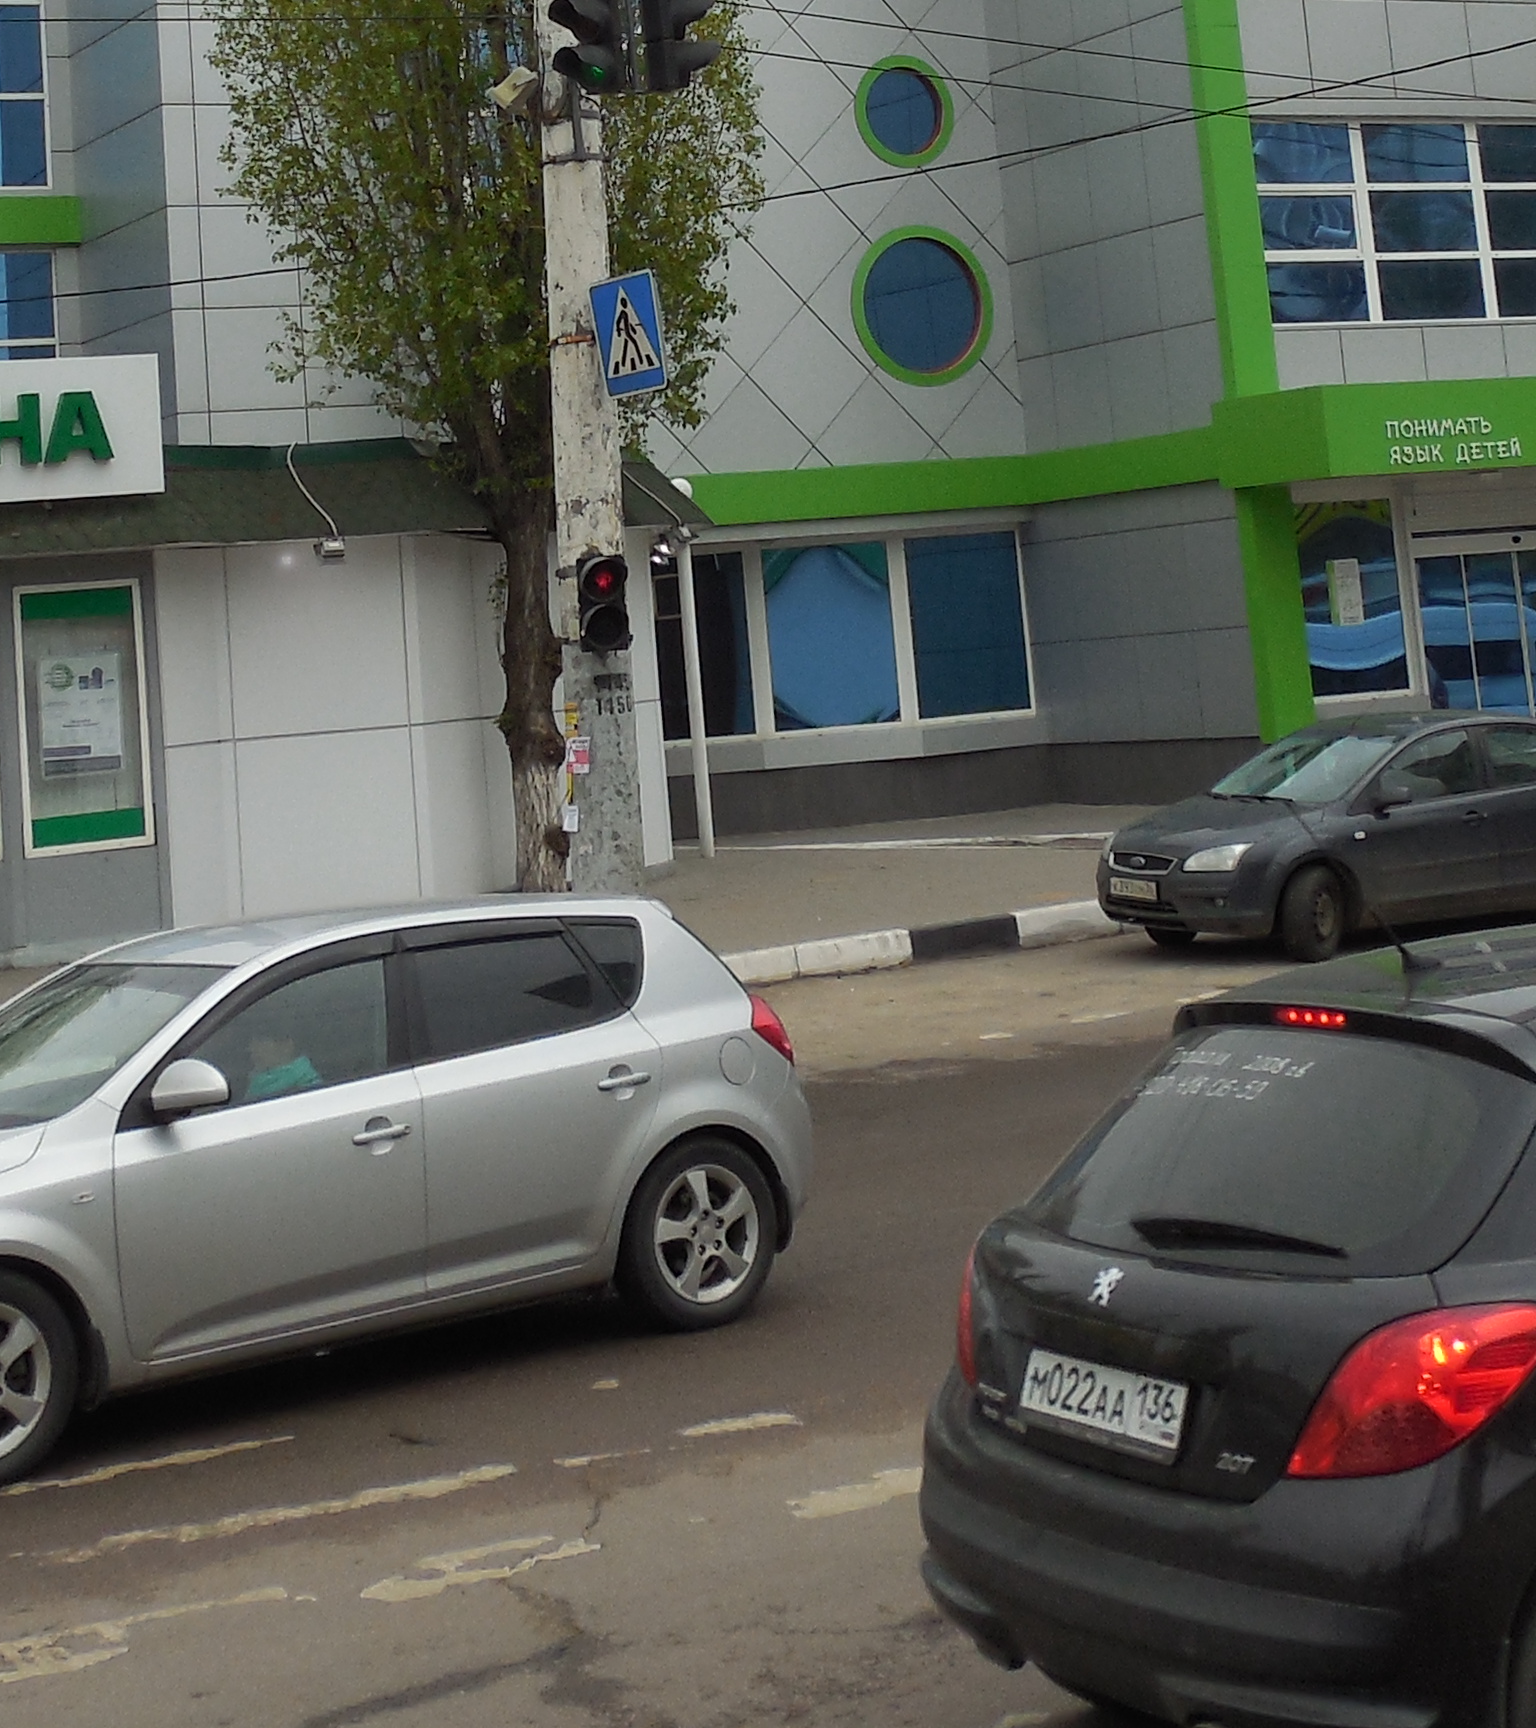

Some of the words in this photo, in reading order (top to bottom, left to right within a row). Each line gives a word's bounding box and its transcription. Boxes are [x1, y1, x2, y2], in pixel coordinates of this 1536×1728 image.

[1385, 416, 1493, 439] ПОНИМАТЬ
[1390, 443, 1444, 465] ЯЗЫК
[1456, 437, 1522, 464] ДЕТЕЙ
[1215, 1452, 1256, 1474] 207
